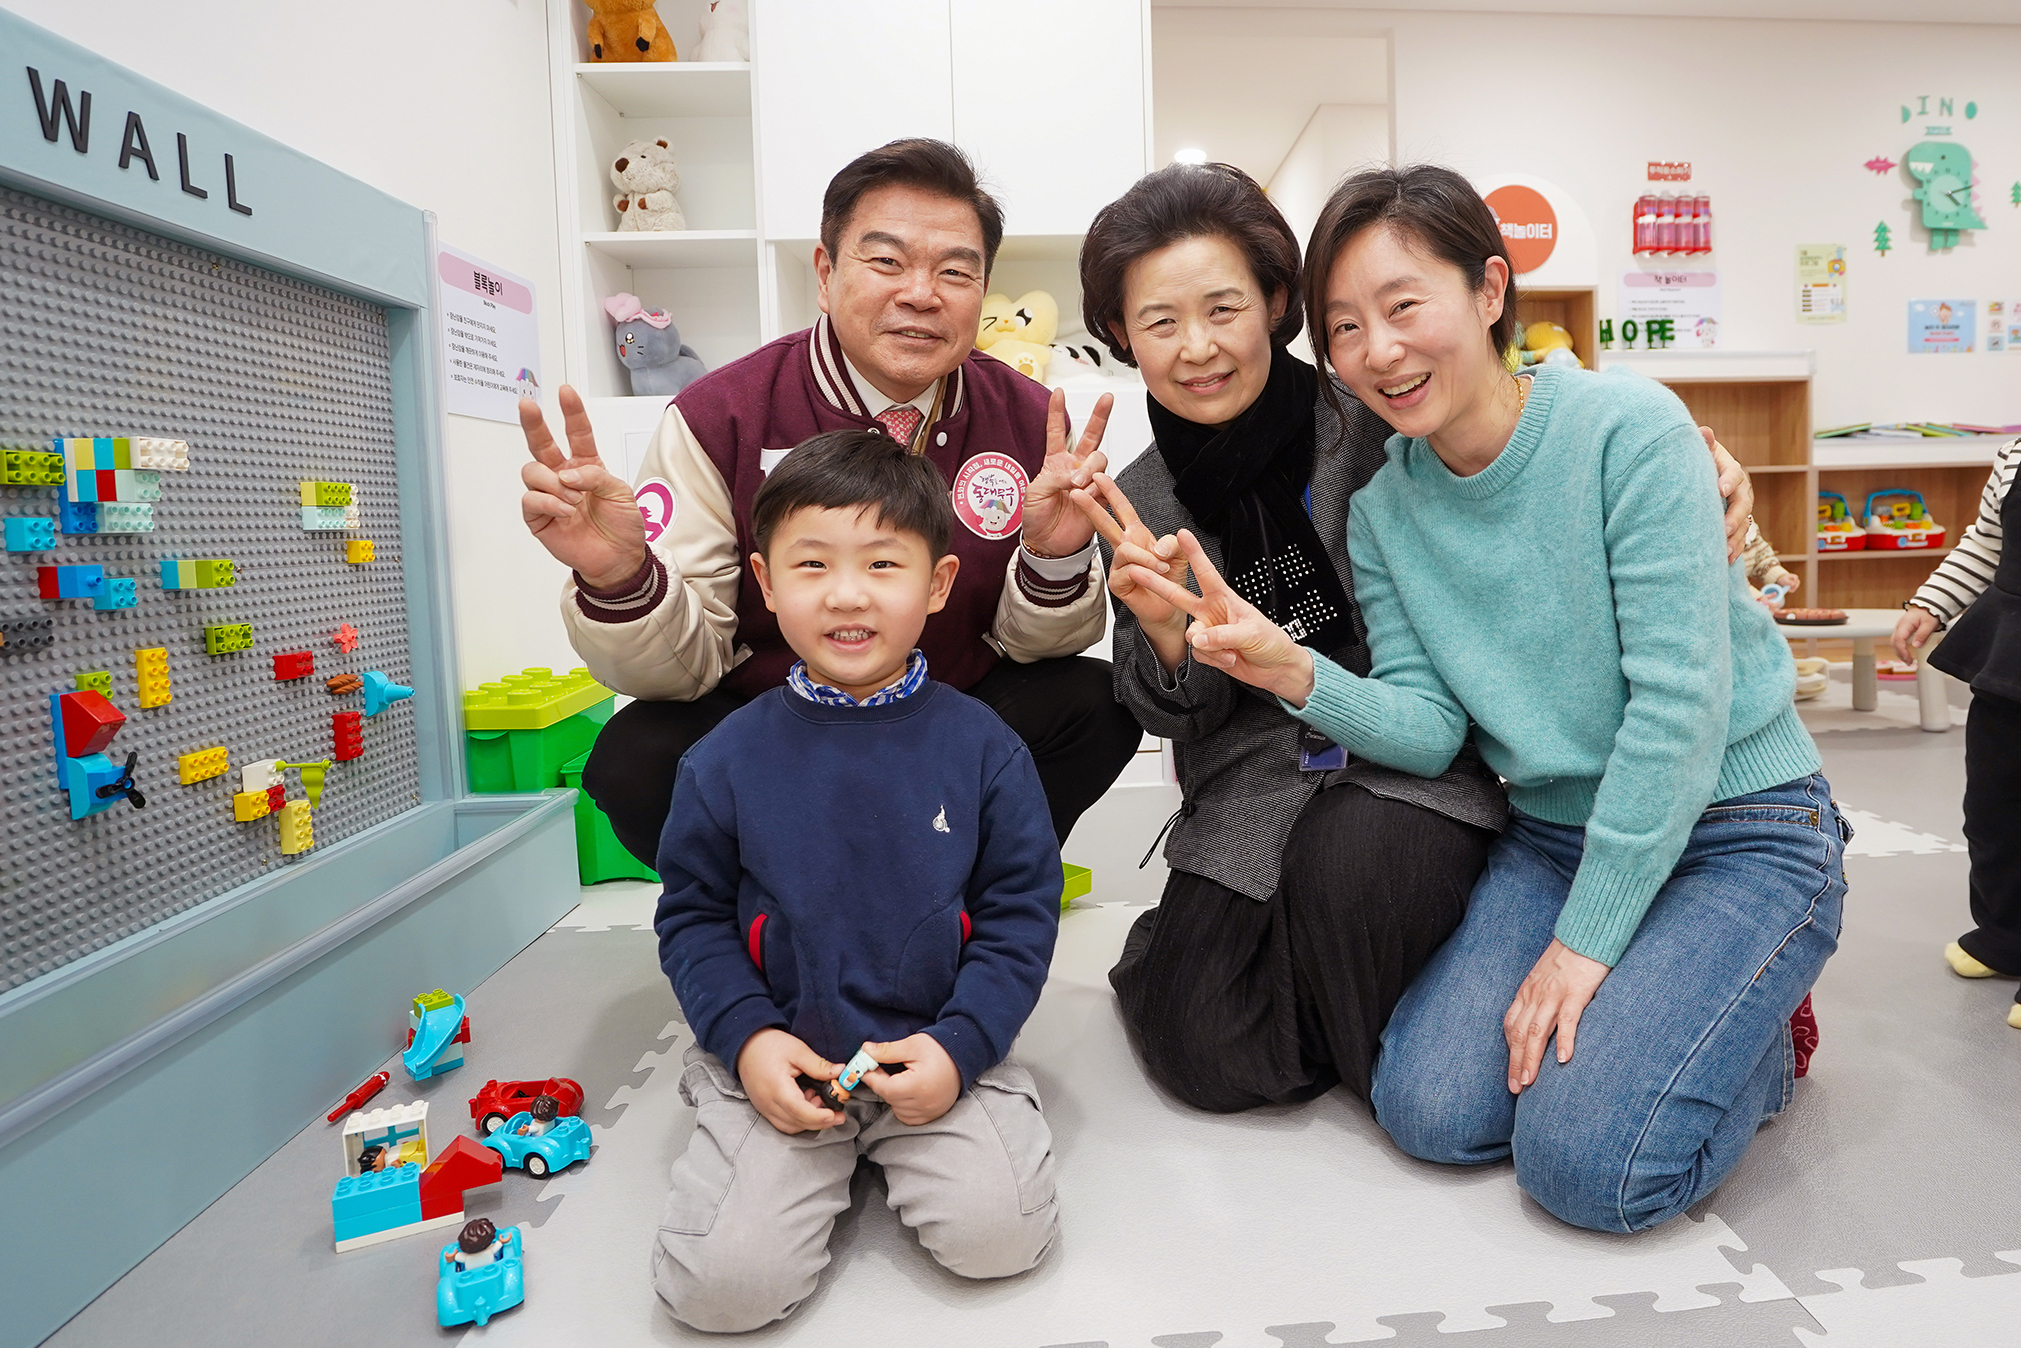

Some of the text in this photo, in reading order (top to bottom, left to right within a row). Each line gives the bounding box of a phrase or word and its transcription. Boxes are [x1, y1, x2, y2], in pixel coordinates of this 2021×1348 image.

[1901, 95, 1978, 124] DINO
[26, 65, 253, 216] WALL
[1500, 222, 1552, 239] 책놀이터
[473, 270, 503, 296] 블록놀이
[1665, 275, 1687, 284] 놀이터
[1599, 319, 1675, 343] HOPE
[983, 458, 1004, 467] 새로운
[1004, 462, 1021, 480] 내일을
[971, 482, 1015, 507] 동대문구
